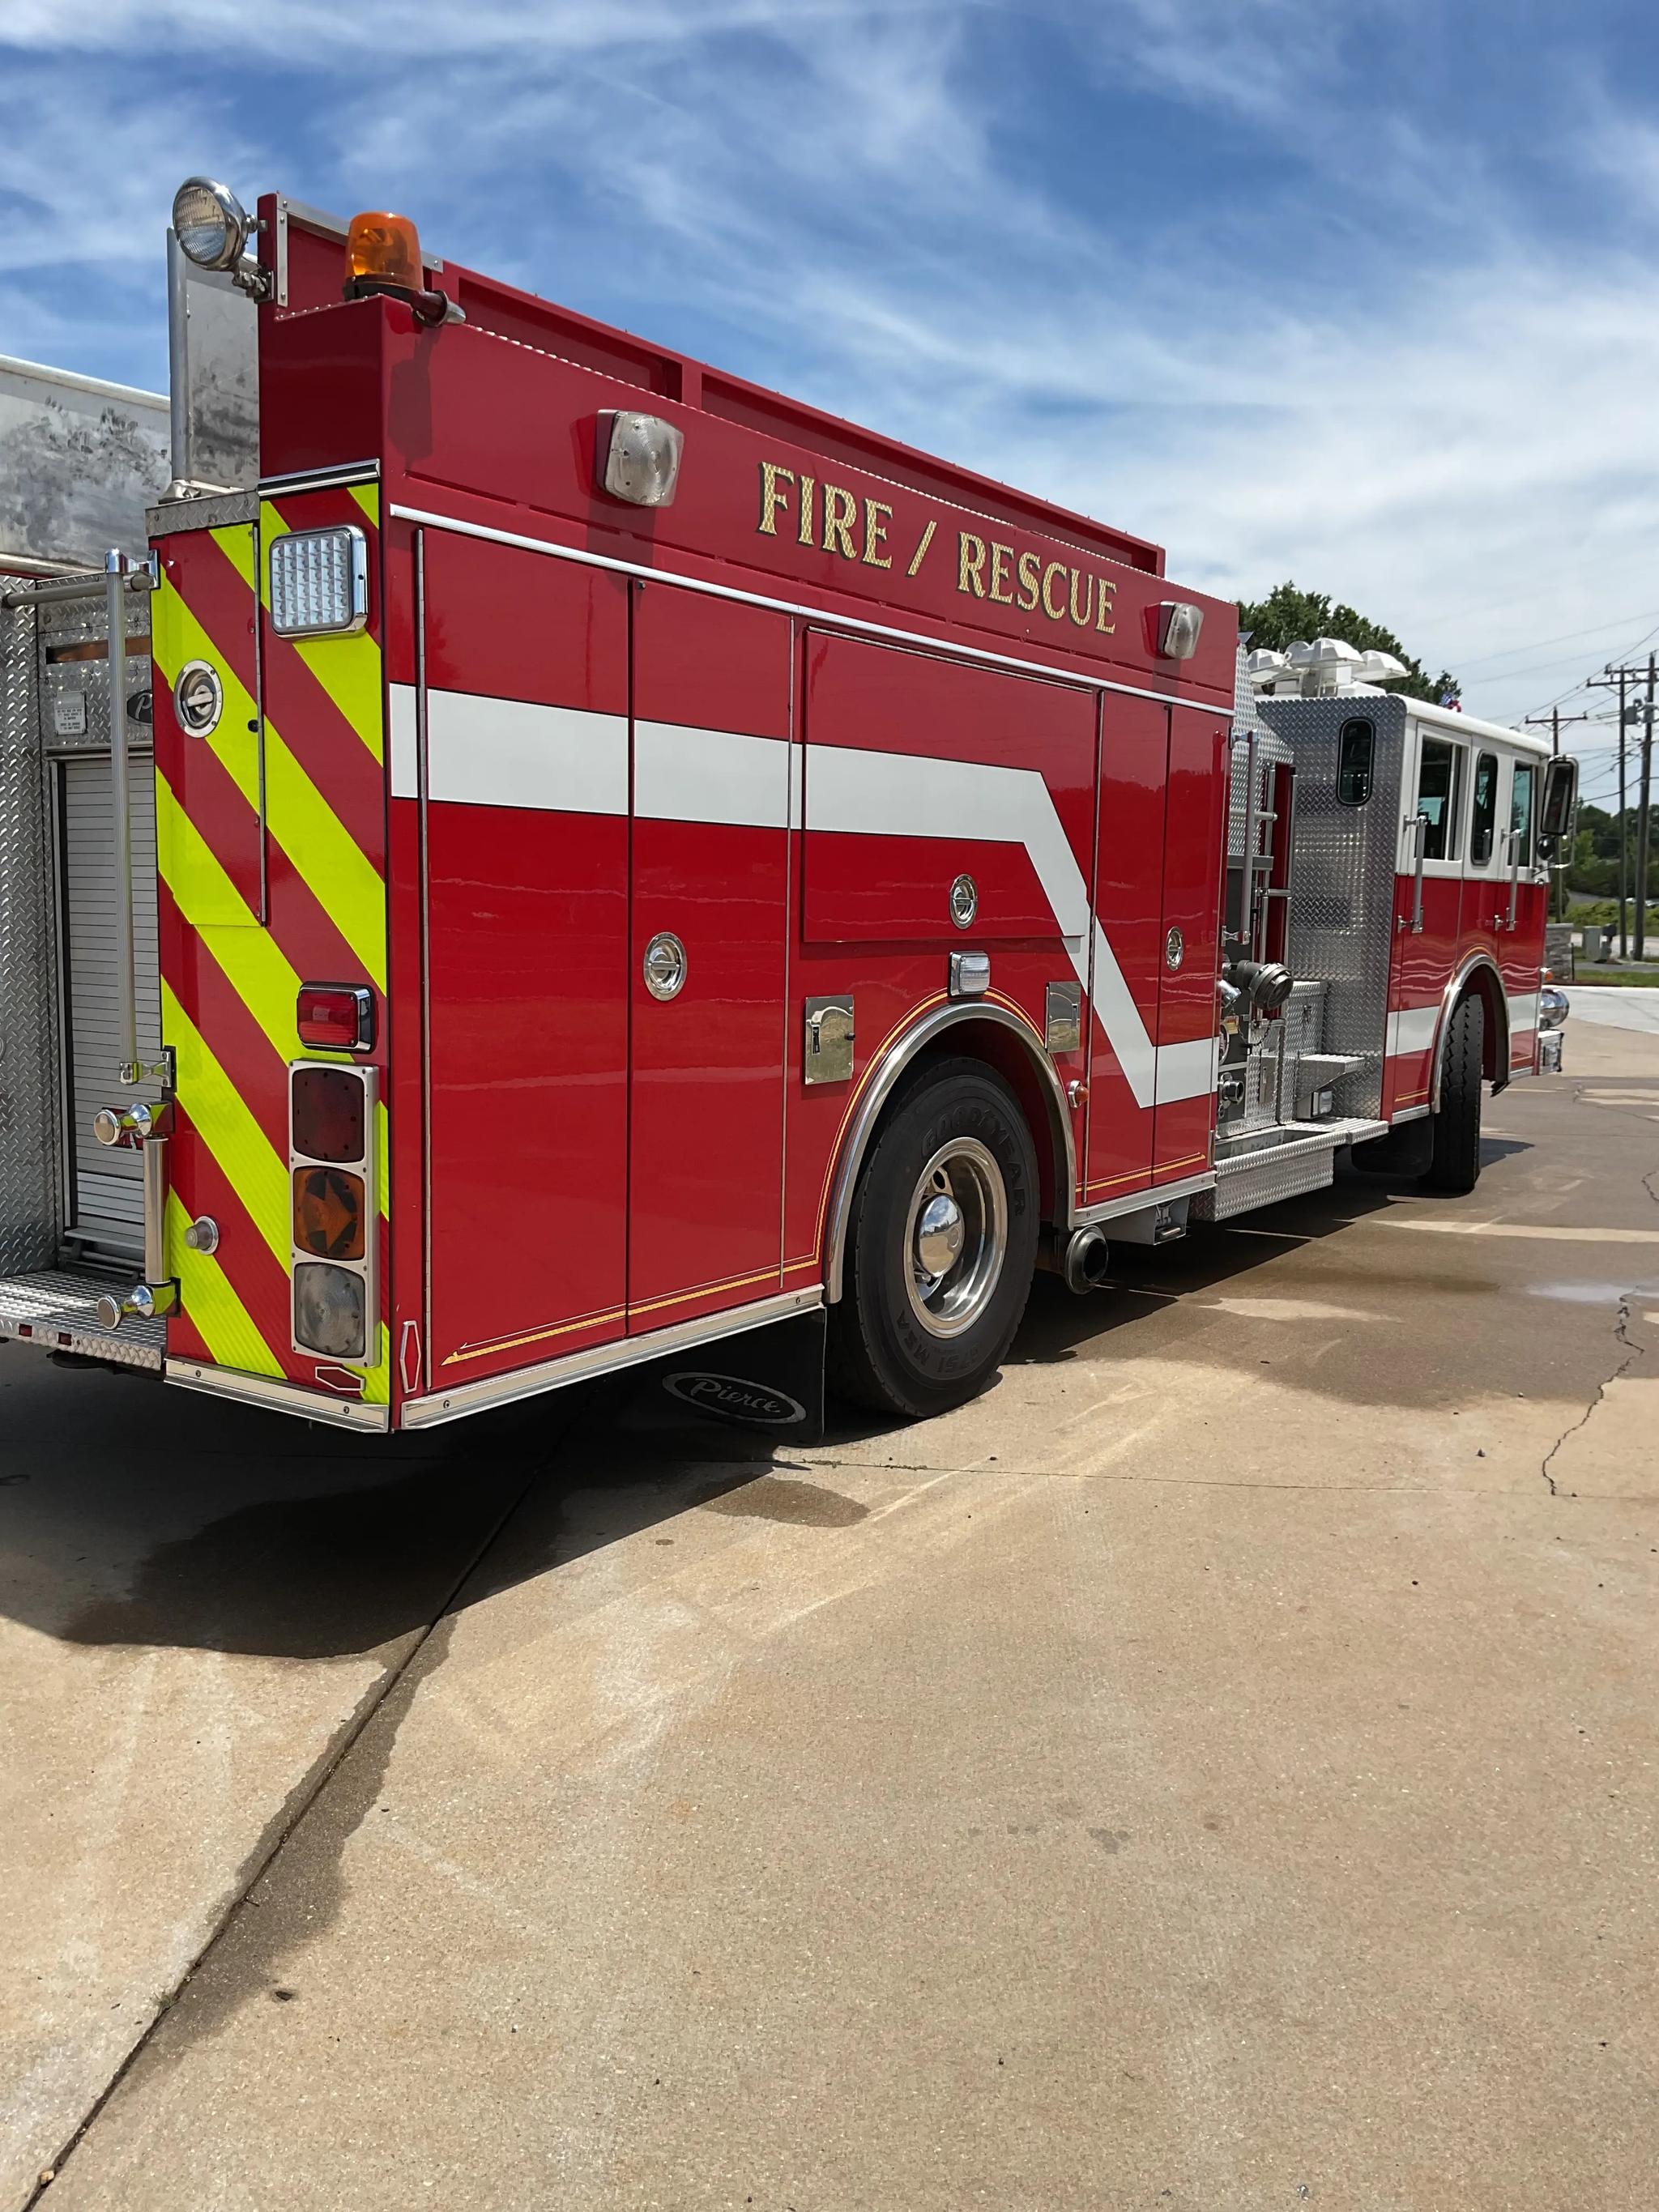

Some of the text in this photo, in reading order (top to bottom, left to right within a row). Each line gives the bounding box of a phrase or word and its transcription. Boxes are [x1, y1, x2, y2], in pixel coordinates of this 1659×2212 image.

[757, 462, 1117, 634] FIRE / RESCUE
[921, 1105, 1026, 1217] GOODYEAR
[690, 1378, 781, 1413] Pierce
